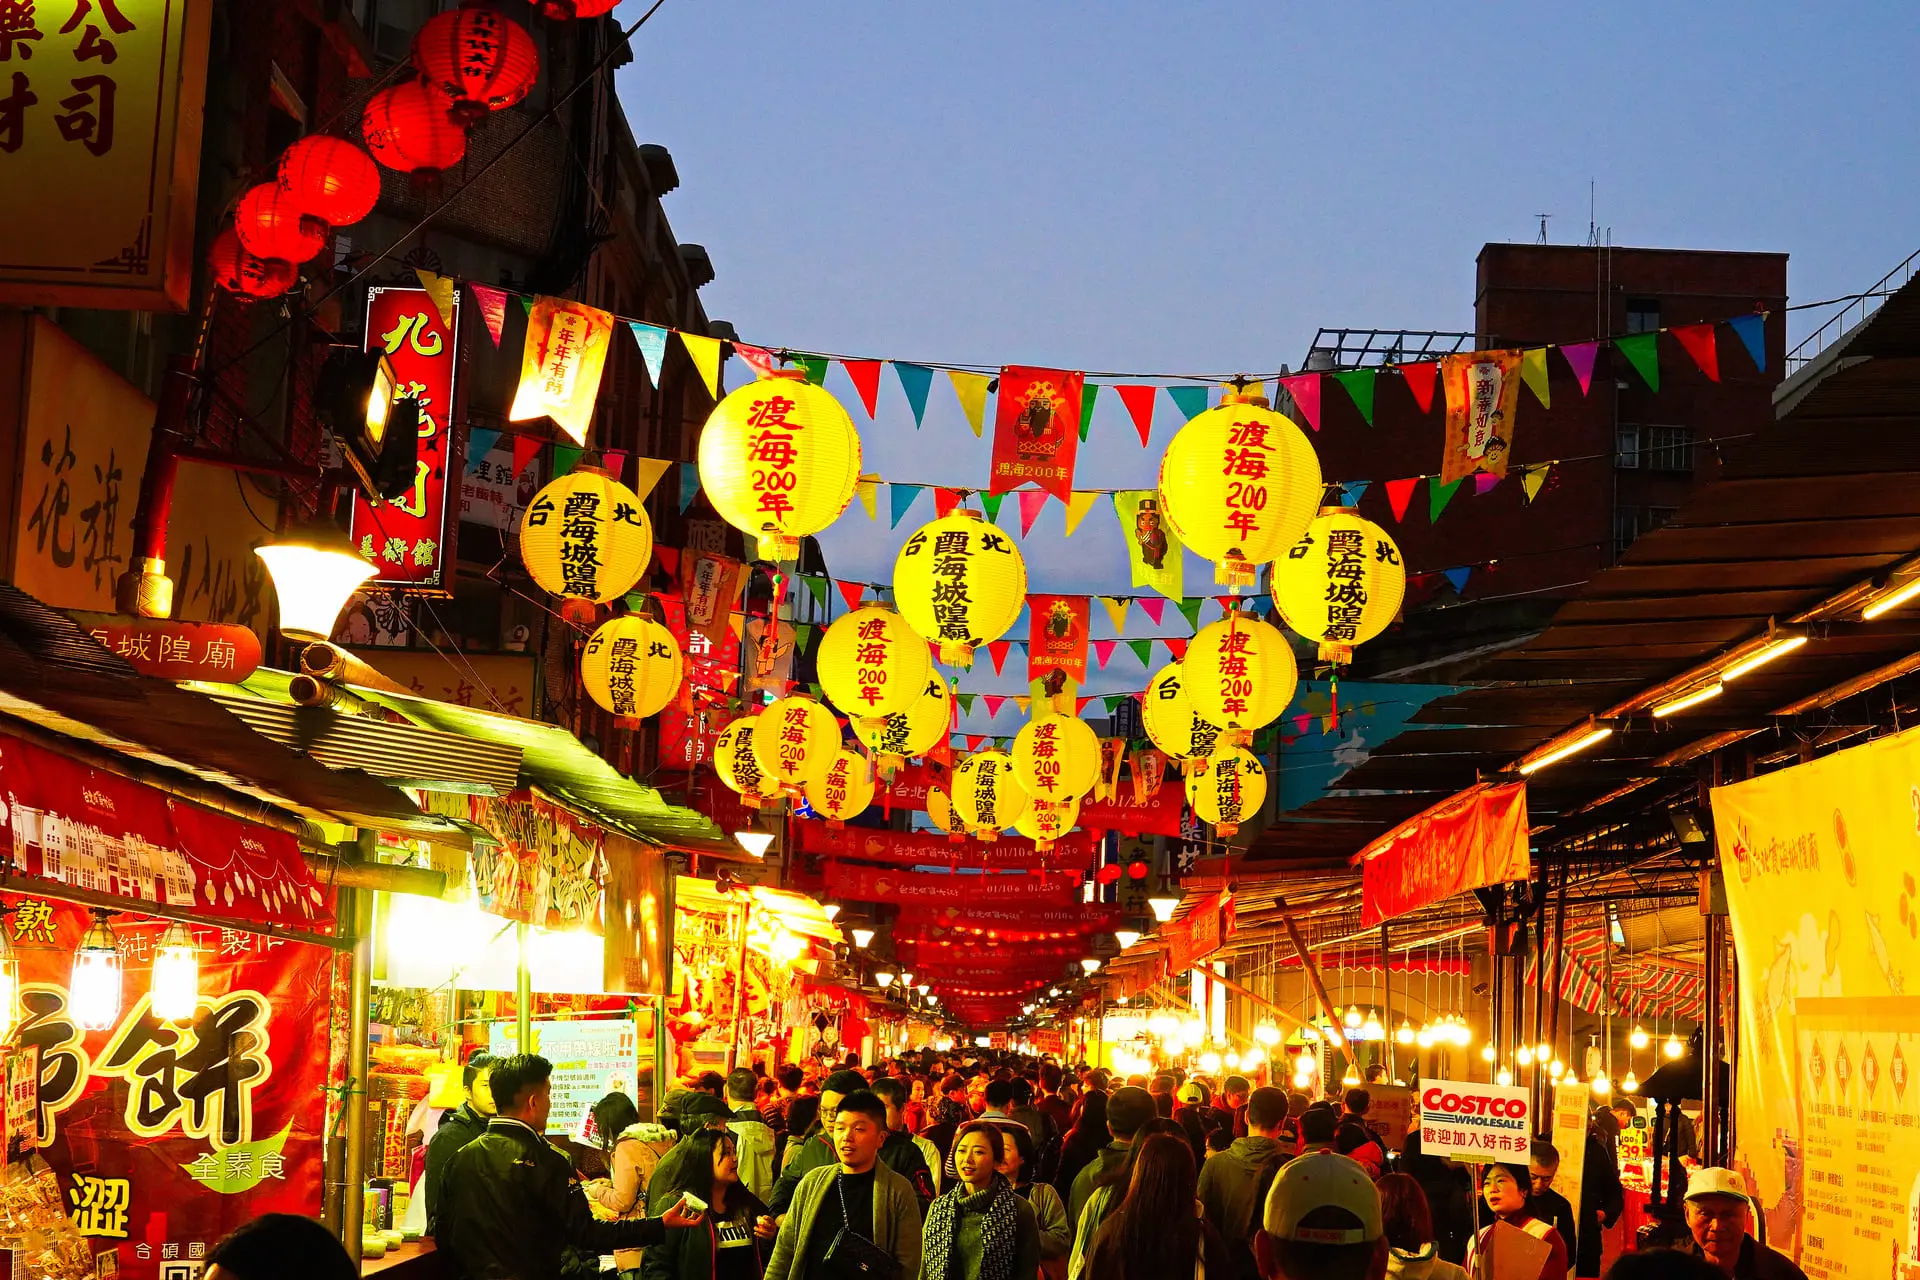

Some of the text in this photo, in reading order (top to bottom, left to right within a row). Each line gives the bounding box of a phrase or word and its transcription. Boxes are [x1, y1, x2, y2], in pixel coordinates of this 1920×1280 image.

[54, 0, 137, 157] 公司
[746, 395, 805, 523] 渡海200年
[995, 462, 1068, 480] 渡海200年
[1222, 420, 1277, 541] 渡海200年
[529, 494, 642, 527] 台 北
[559, 491, 605, 599] 霞海城隍廟
[905, 531, 1011, 556] 台 北
[1375, 540, 1400, 566] 北
[931, 531, 975, 641] 霞海城隍廟
[1321, 529, 1368, 641] 霞海城隍廟
[587, 632, 672, 660] 台 北
[855, 618, 894, 707] 渡海200年
[1217, 631, 1258, 718] 渡海200年
[1158, 675, 1182, 700] 台
[717, 728, 732, 748] 台
[779, 707, 811, 776] 渡海200年
[960, 758, 974, 773] 台
[1032, 722, 1061, 794] 渡海200年
[1244, 759, 1263, 776] 北
[974, 759, 998, 826] 霞海城隍廟
[995, 846, 1025, 857] 01/10
[986, 885, 1014, 894] 01/10
[13, 899, 58, 944] 熟
[1422, 1087, 1527, 1119] COSTCO
[1454, 1115, 1524, 1130] WHOLESALE
[1422, 1126, 1528, 1152] 歡迎加入好市多
[1621, 1145, 1640, 1158] 39
[191, 1150, 287, 1181] 全素食
[69, 1172, 131, 1239] 澀
